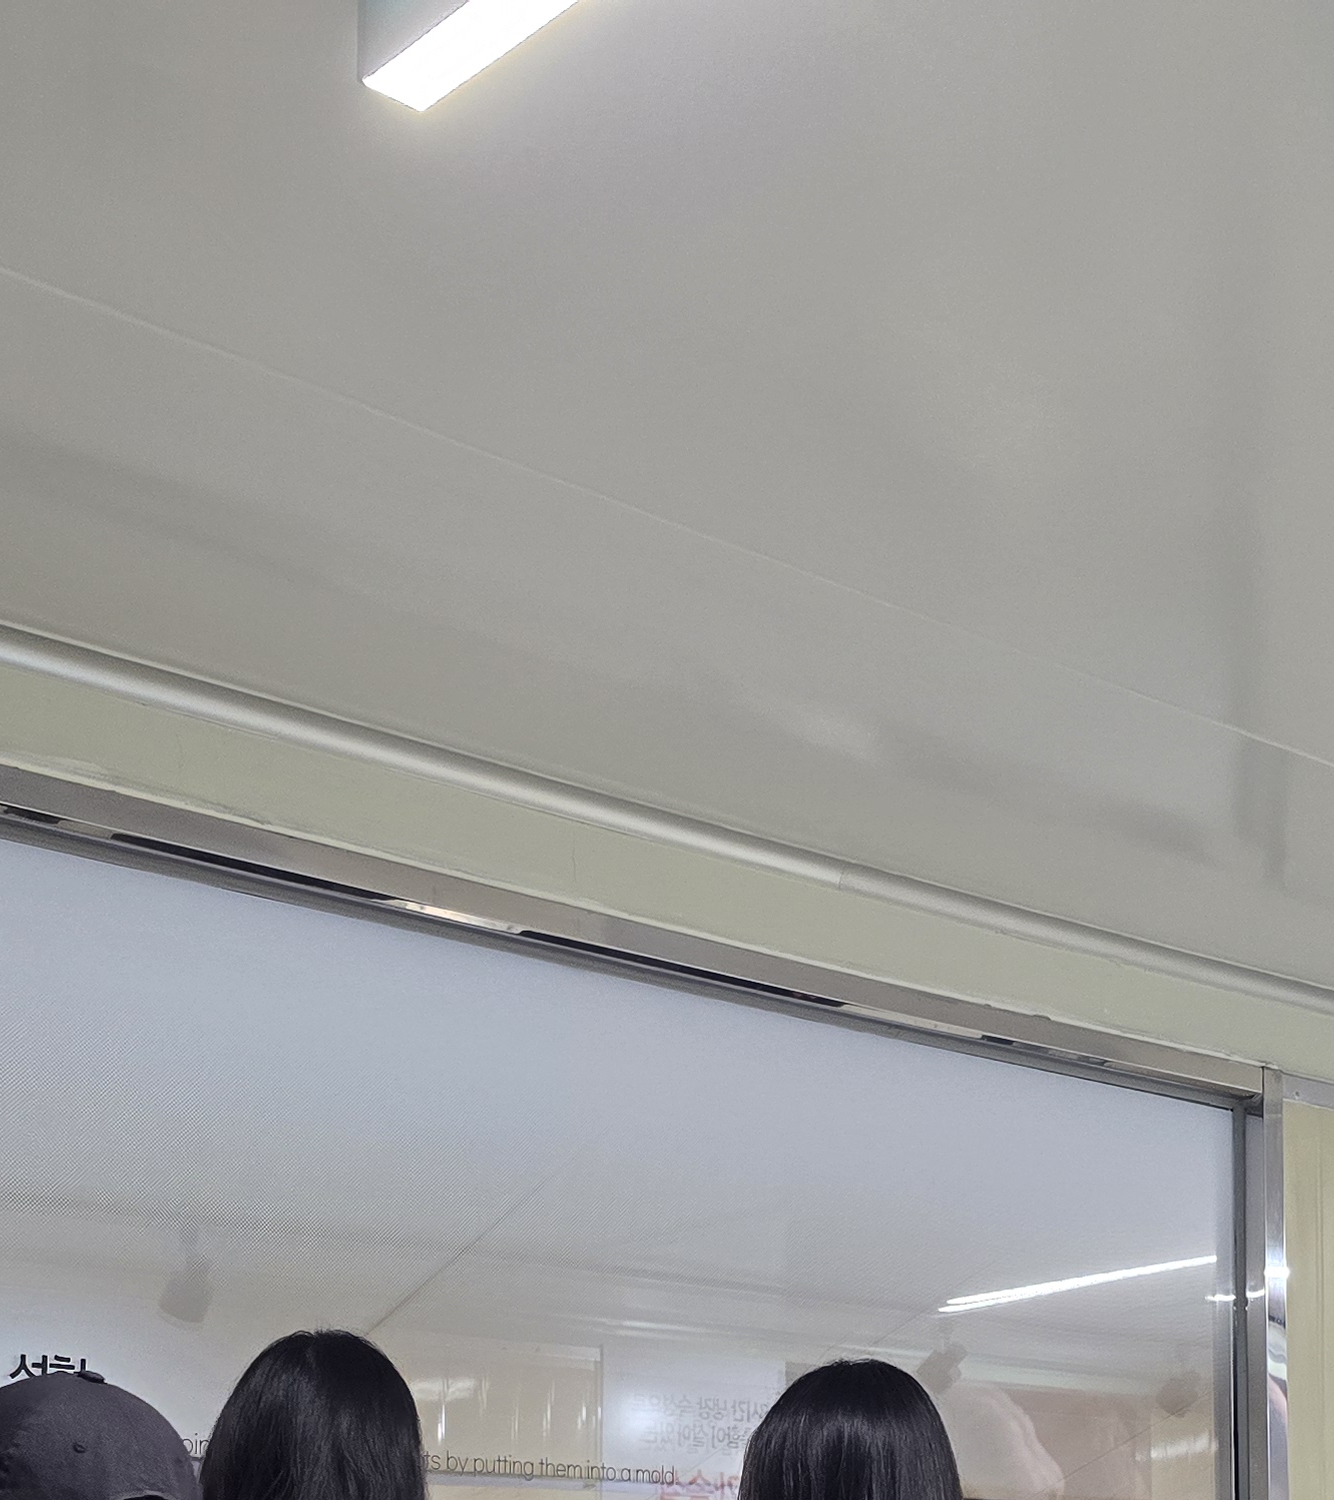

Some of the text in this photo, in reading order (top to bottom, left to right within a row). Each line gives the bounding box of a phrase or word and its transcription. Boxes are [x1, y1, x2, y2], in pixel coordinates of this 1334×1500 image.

[446, 1450, 469, 1476] by
[473, 1454, 534, 1481] putting
[539, 1457, 583, 1480] them
[586, 1459, 616, 1481] into
[620, 1467, 631, 1482] a
